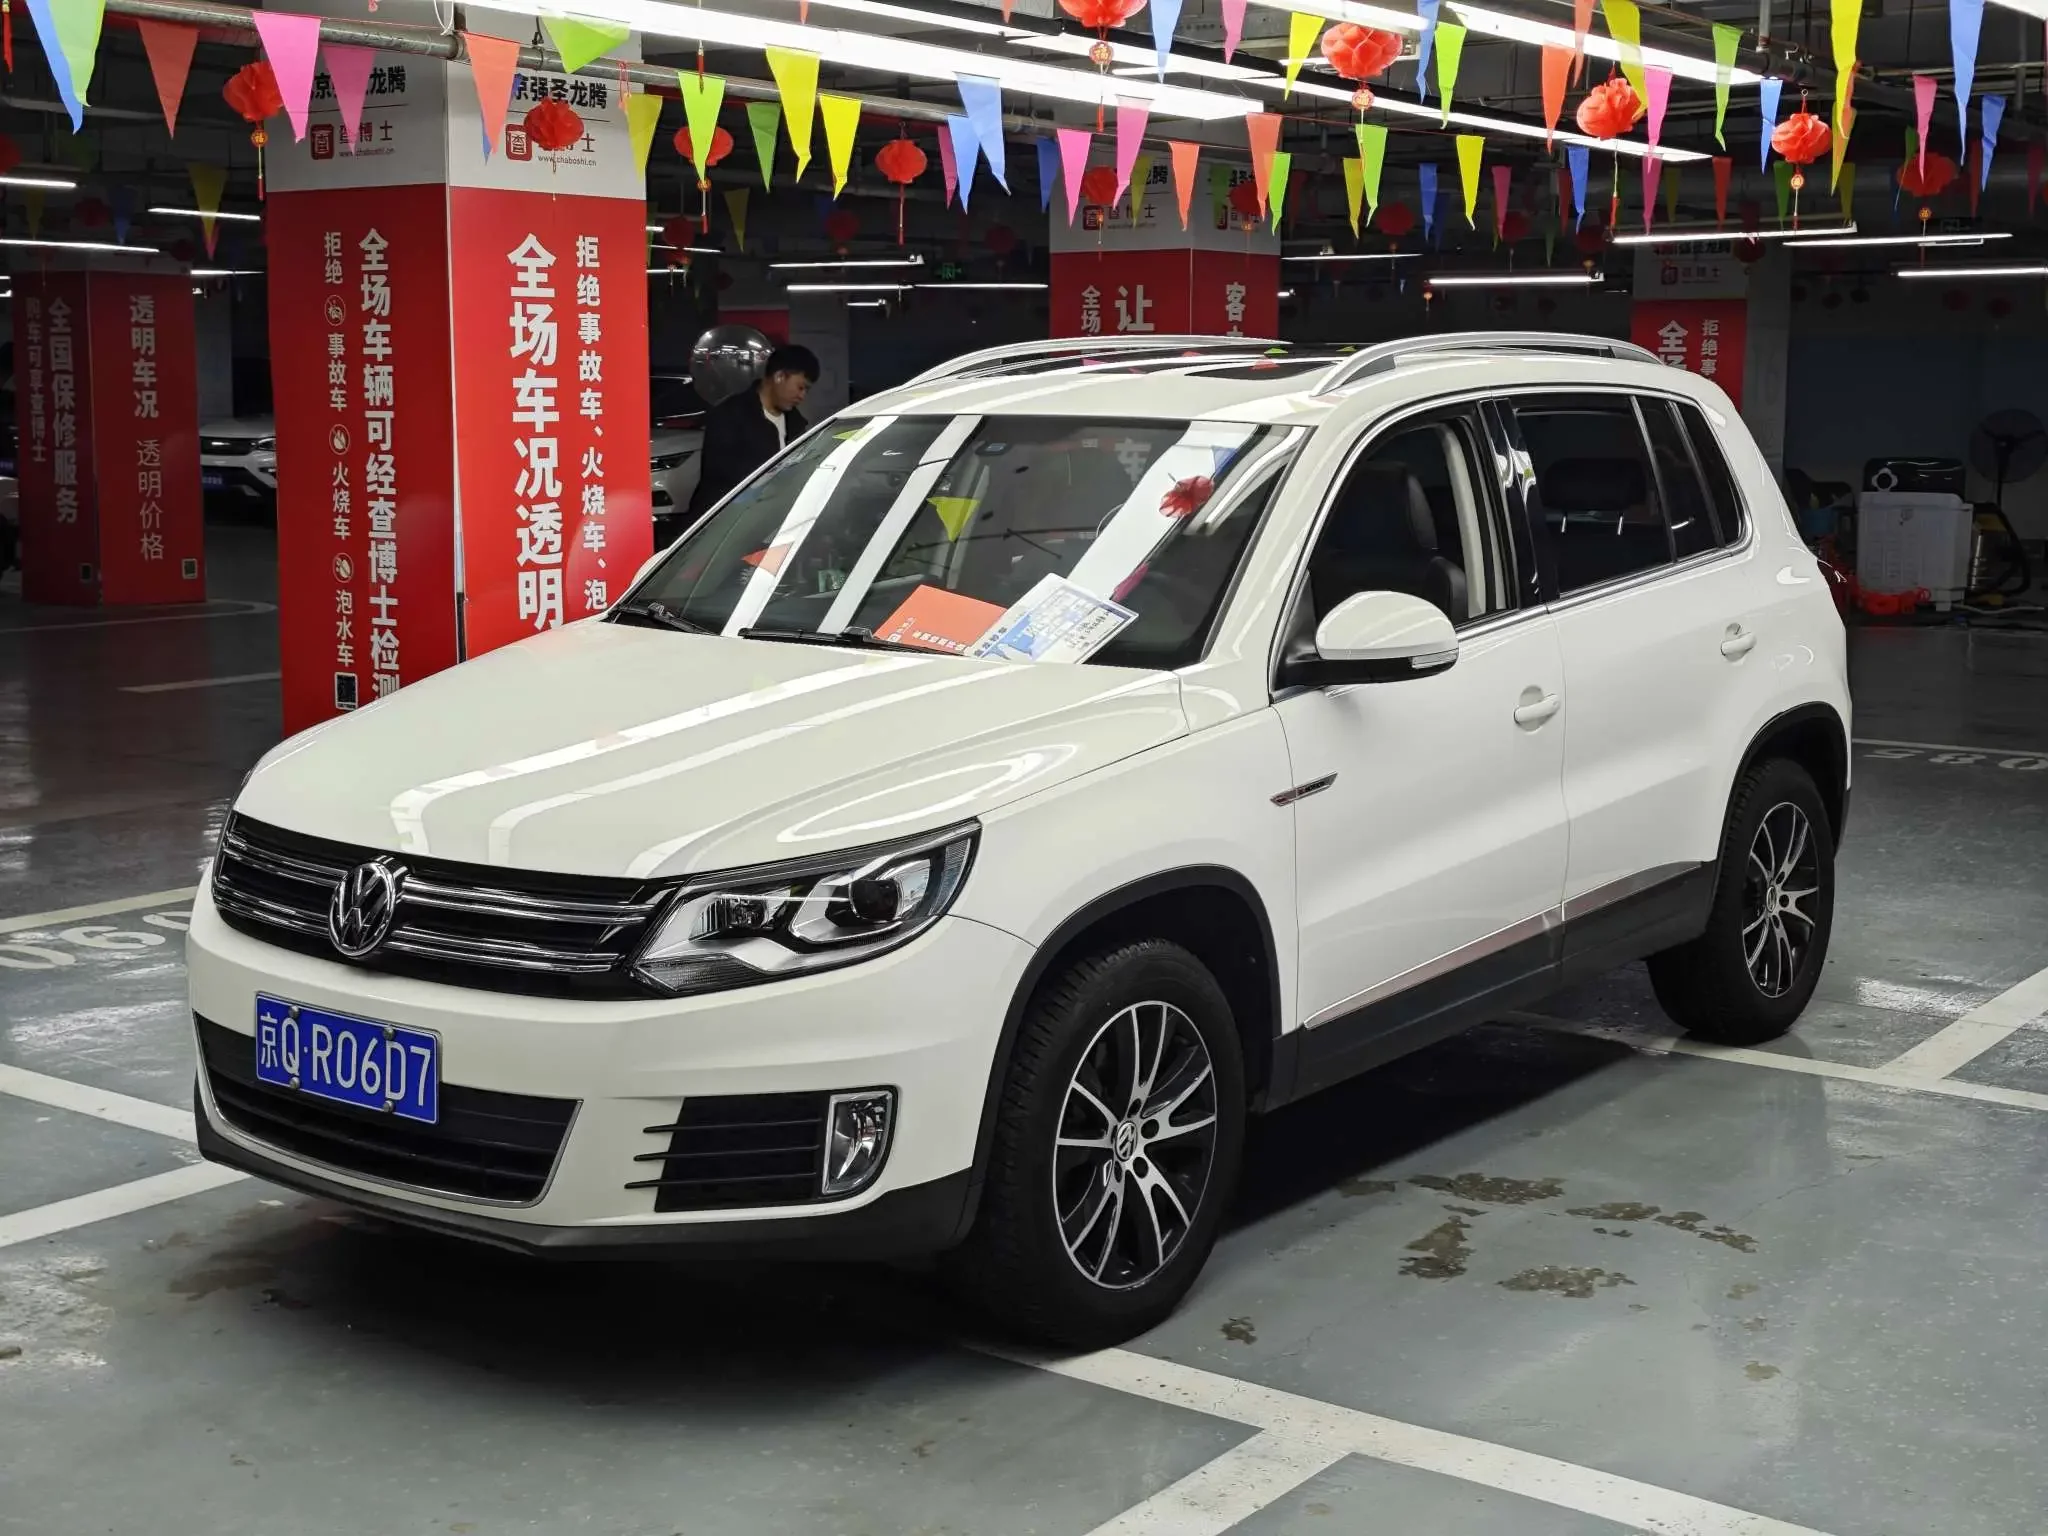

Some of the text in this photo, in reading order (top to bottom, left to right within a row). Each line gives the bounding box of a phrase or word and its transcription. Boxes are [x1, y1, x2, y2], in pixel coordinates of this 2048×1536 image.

[49, 297, 79, 525] 全国保修服务
[1115, 284, 1155, 332] 让
[1225, 281, 1247, 337] 客
[130, 295, 164, 561] 透明车况 透明价格
[324, 231, 355, 668] 拒绝 事故车 火烧车 泡水车
[507, 232, 564, 631] 全场车况透明
[260, 1011, 432, 1107] 京Q·R06D7
